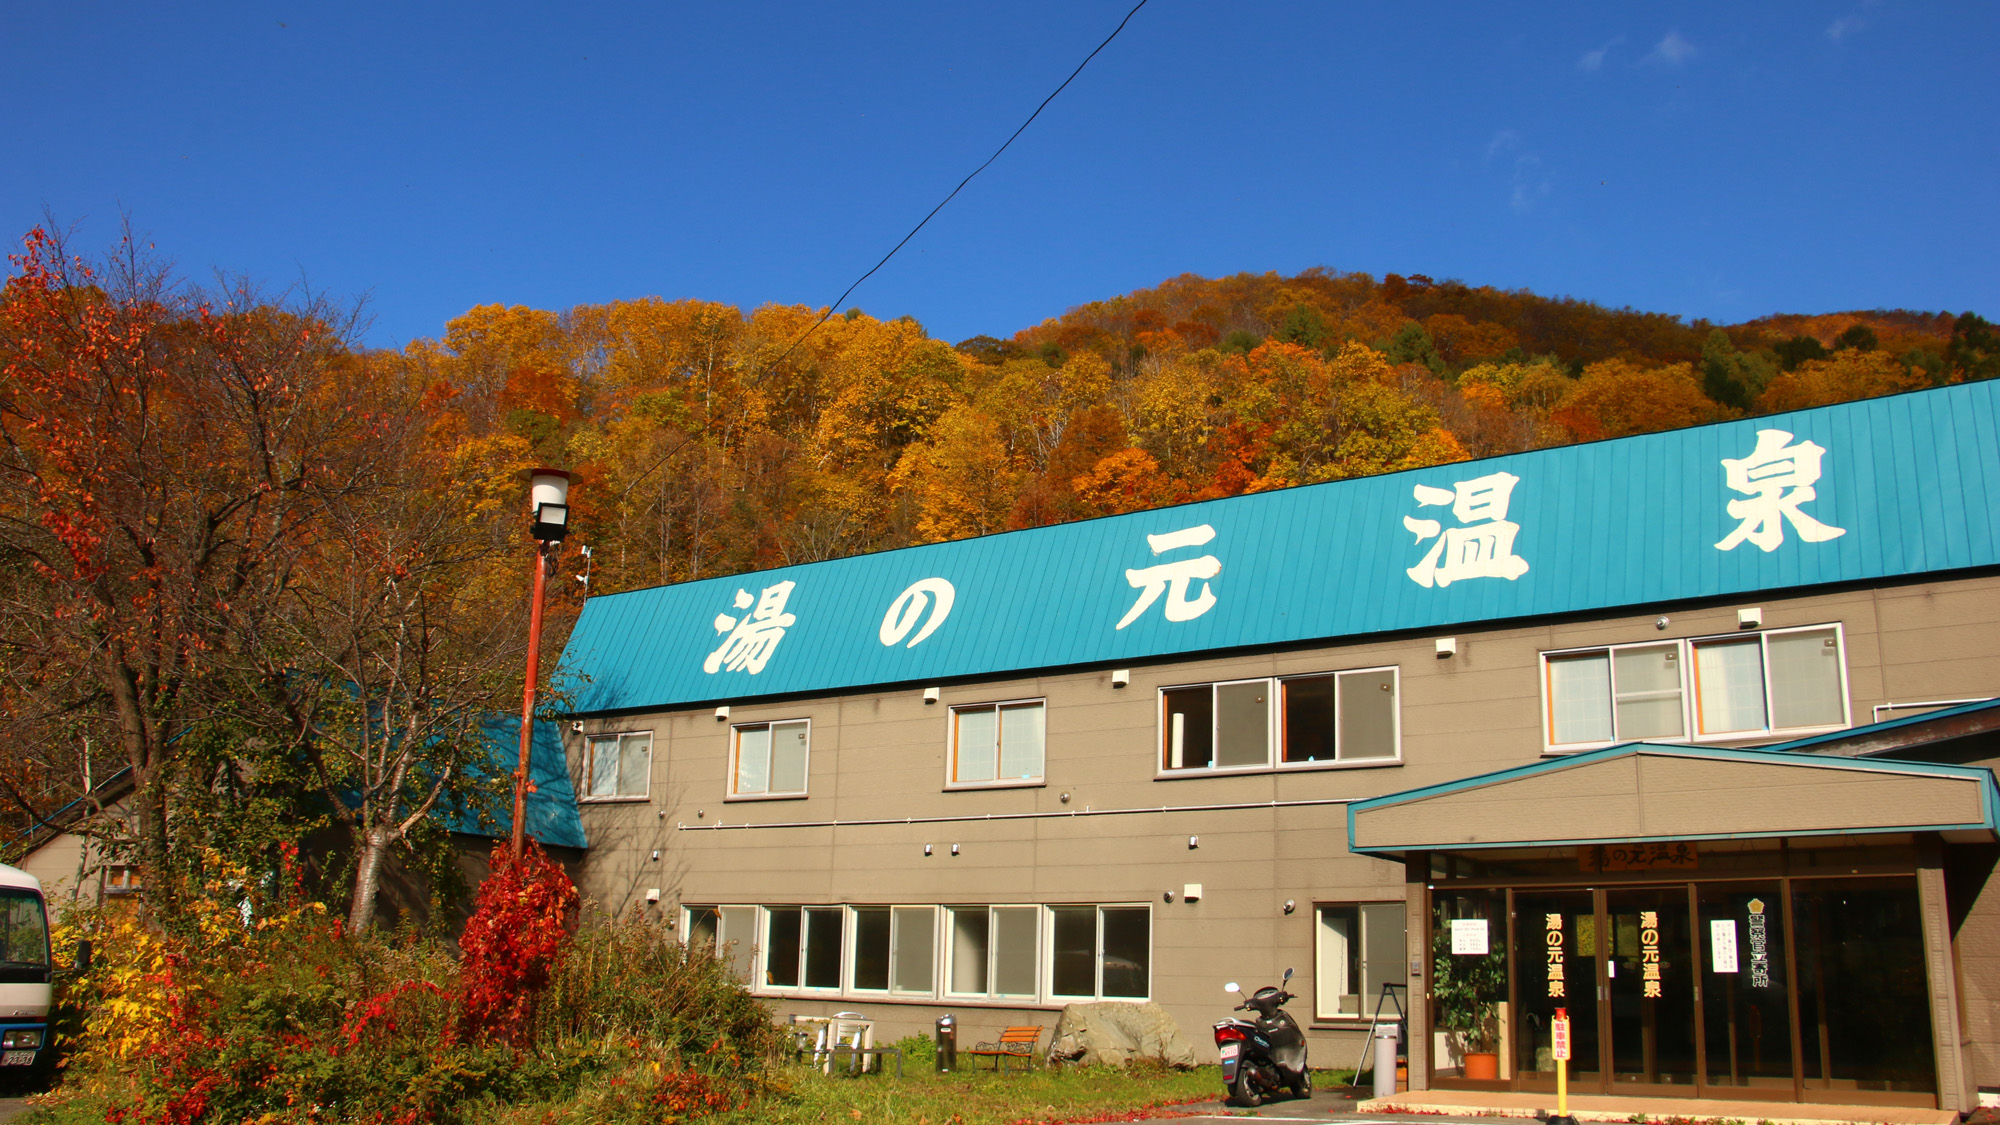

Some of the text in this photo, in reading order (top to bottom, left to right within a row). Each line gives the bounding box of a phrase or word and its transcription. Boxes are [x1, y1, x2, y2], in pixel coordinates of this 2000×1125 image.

[704, 429, 1848, 676] 湯の元温泉
[1545, 913, 1564, 997] 湯の元温泉
[1641, 912, 1661, 997] 湯の元温泉
[1749, 914, 1768, 987] 警察官立寄所
[1555, 1022, 1566, 1057] 駐車禁止
